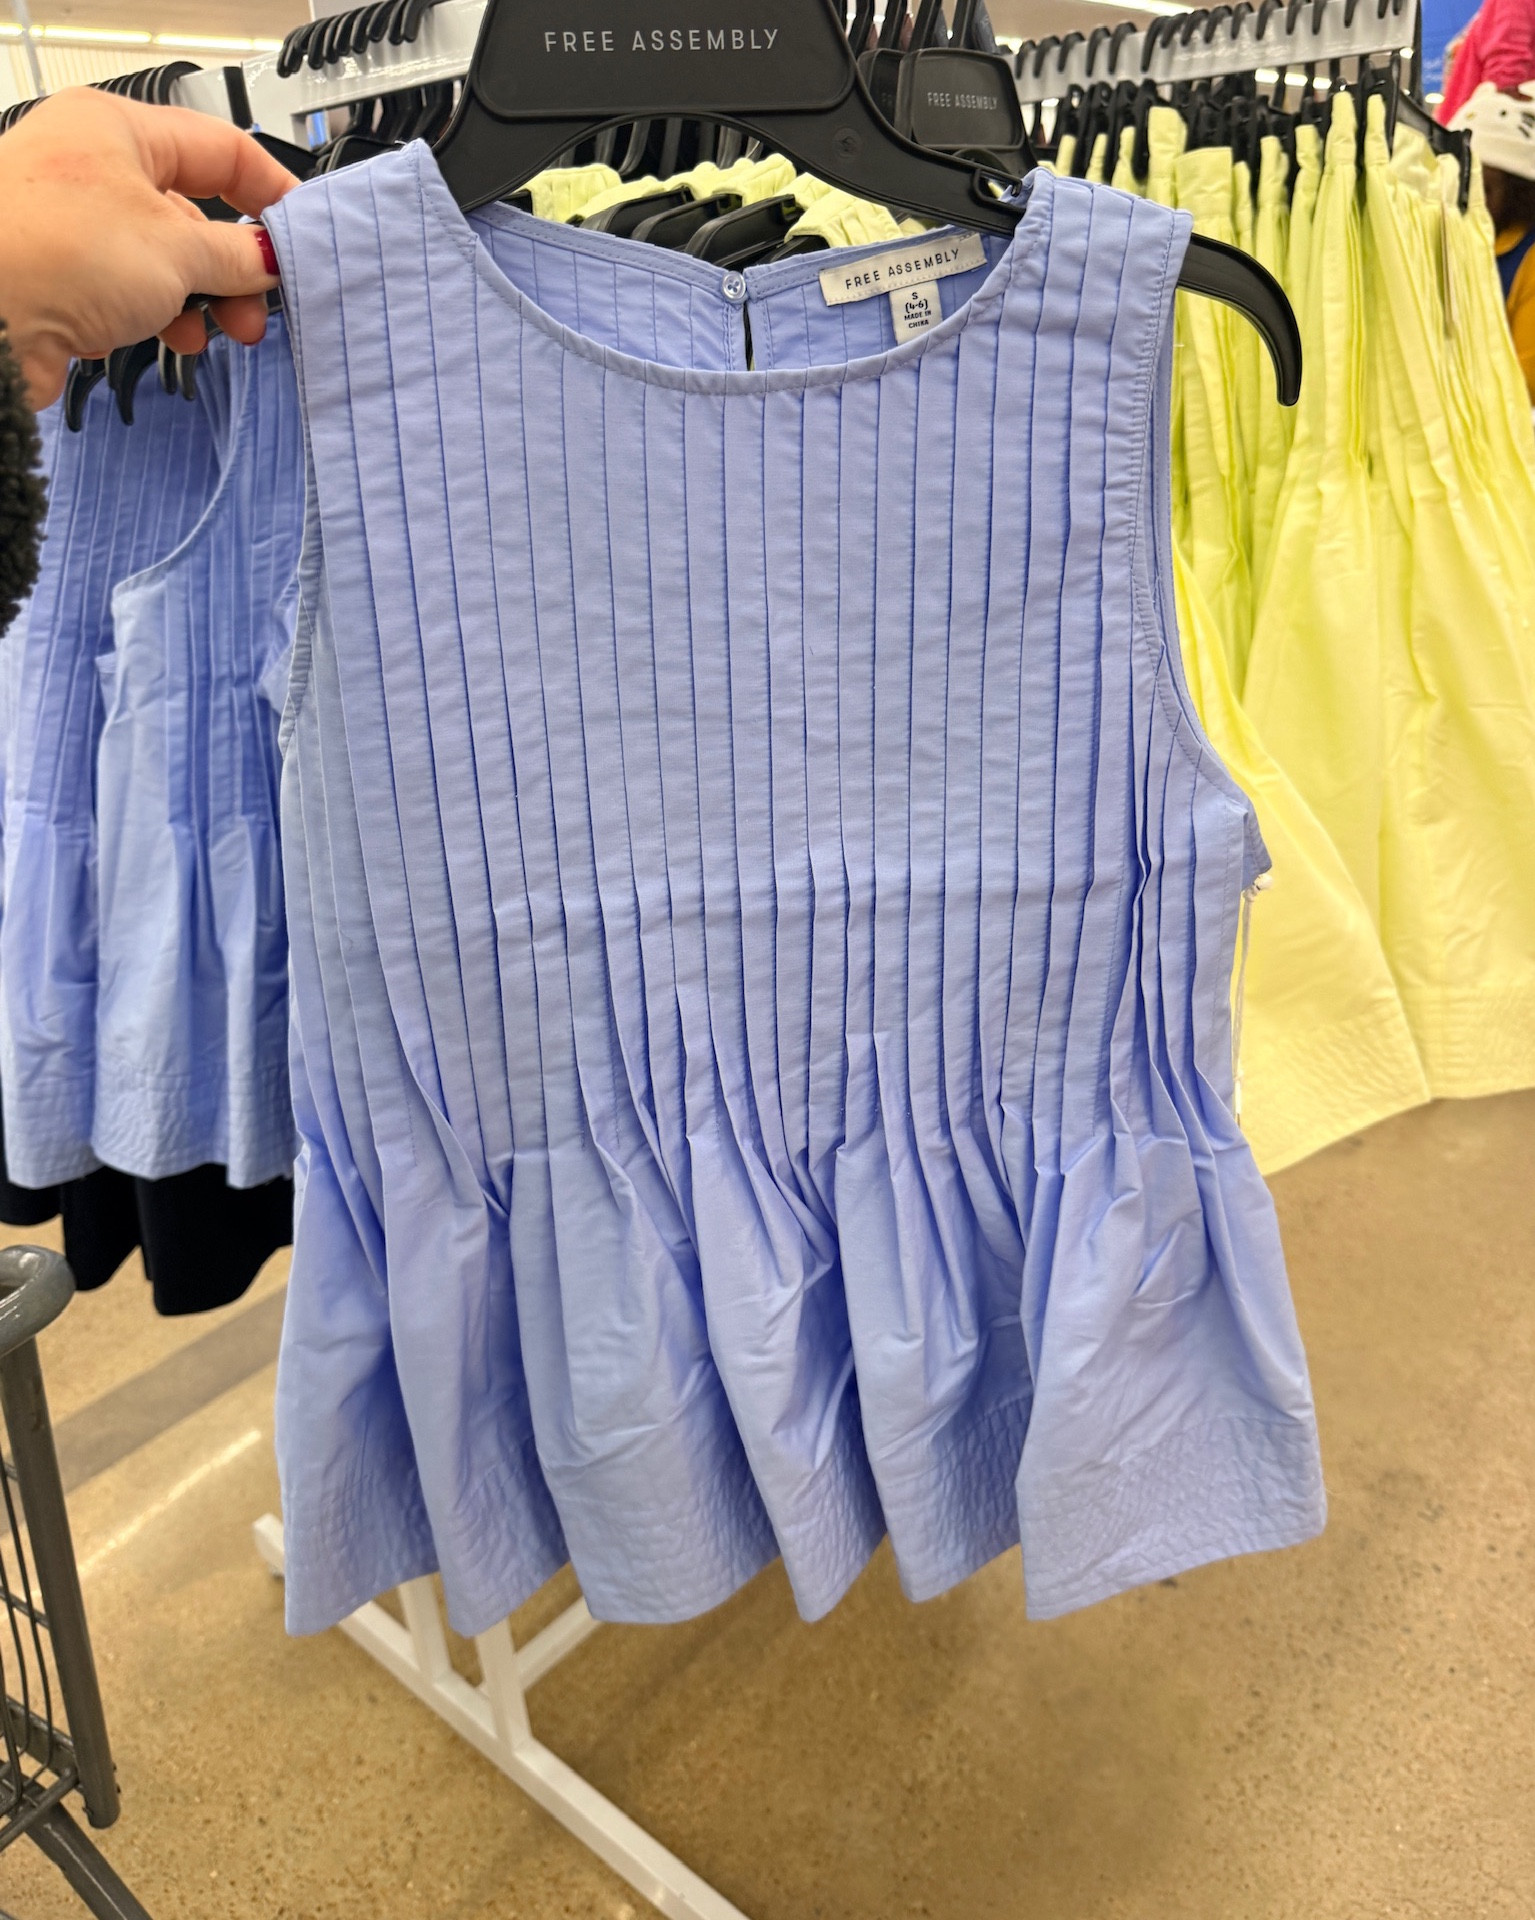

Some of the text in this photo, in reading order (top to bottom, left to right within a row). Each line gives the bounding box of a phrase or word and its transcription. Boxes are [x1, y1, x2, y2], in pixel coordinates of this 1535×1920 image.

[544, 29, 778, 52] FREE ASSEMBLY
[927, 92, 998, 110] FREE ASSEMBLY
[845, 248, 959, 289] FREE ASSEMBLY
[911, 292, 918, 300] S
[904, 312, 922, 321] MADE
[908, 319, 929, 329] CHINA
